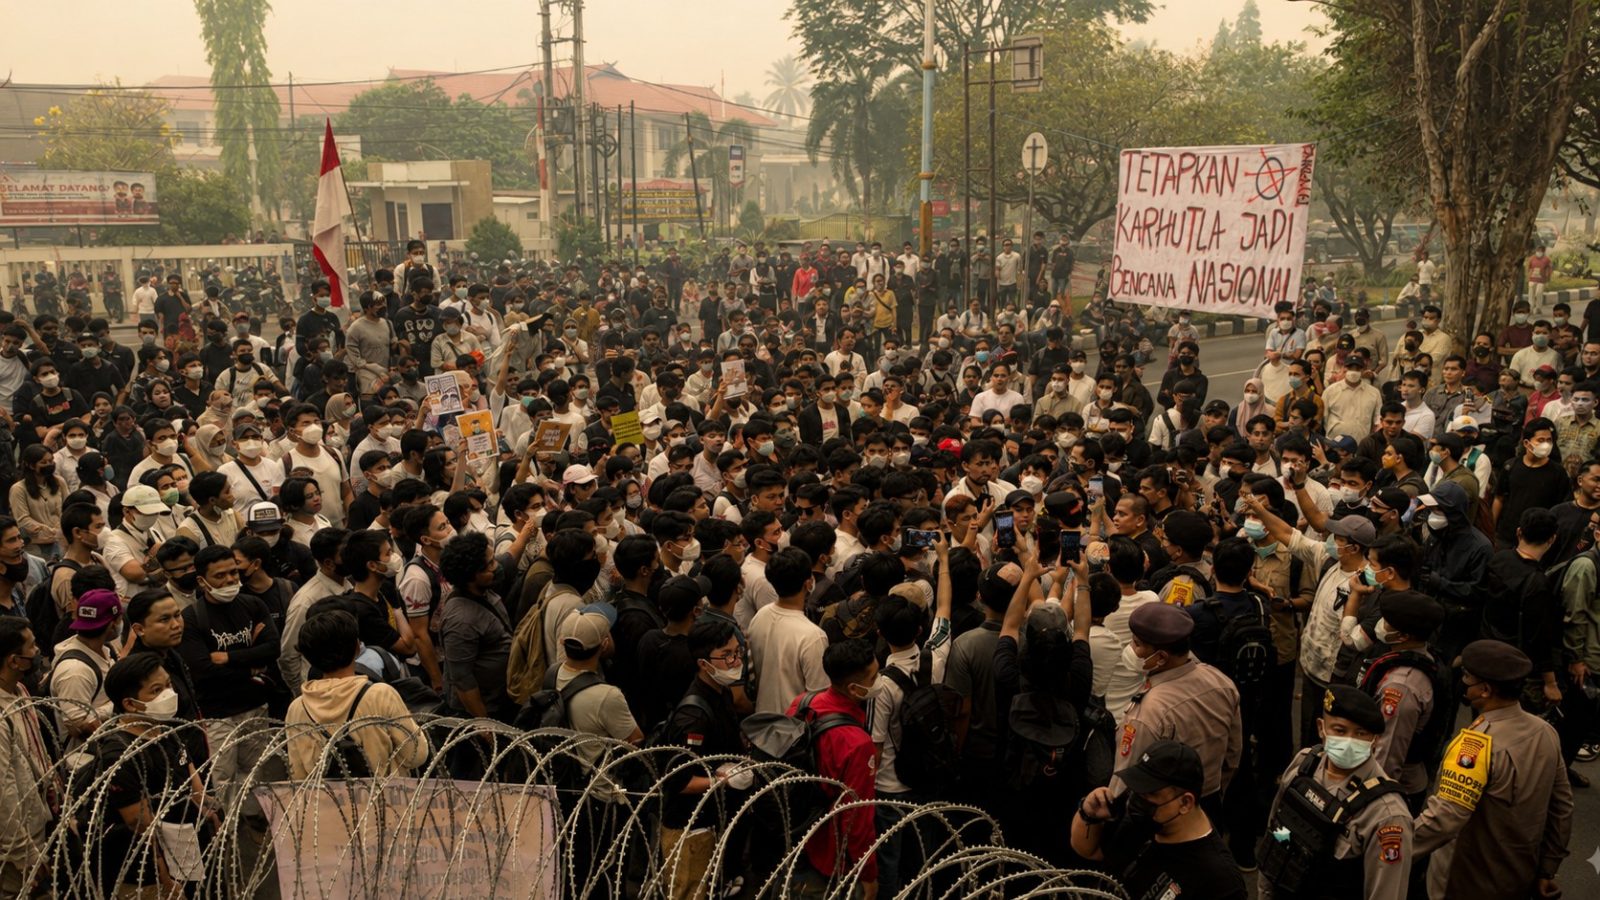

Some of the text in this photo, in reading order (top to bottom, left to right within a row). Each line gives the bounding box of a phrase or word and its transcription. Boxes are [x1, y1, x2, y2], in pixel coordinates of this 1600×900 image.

[1122, 150, 1239, 197] TETAPKAN
[1116, 203, 1294, 254] KARHUTLA JADI
[1110, 255, 1176, 299] BENCANA
